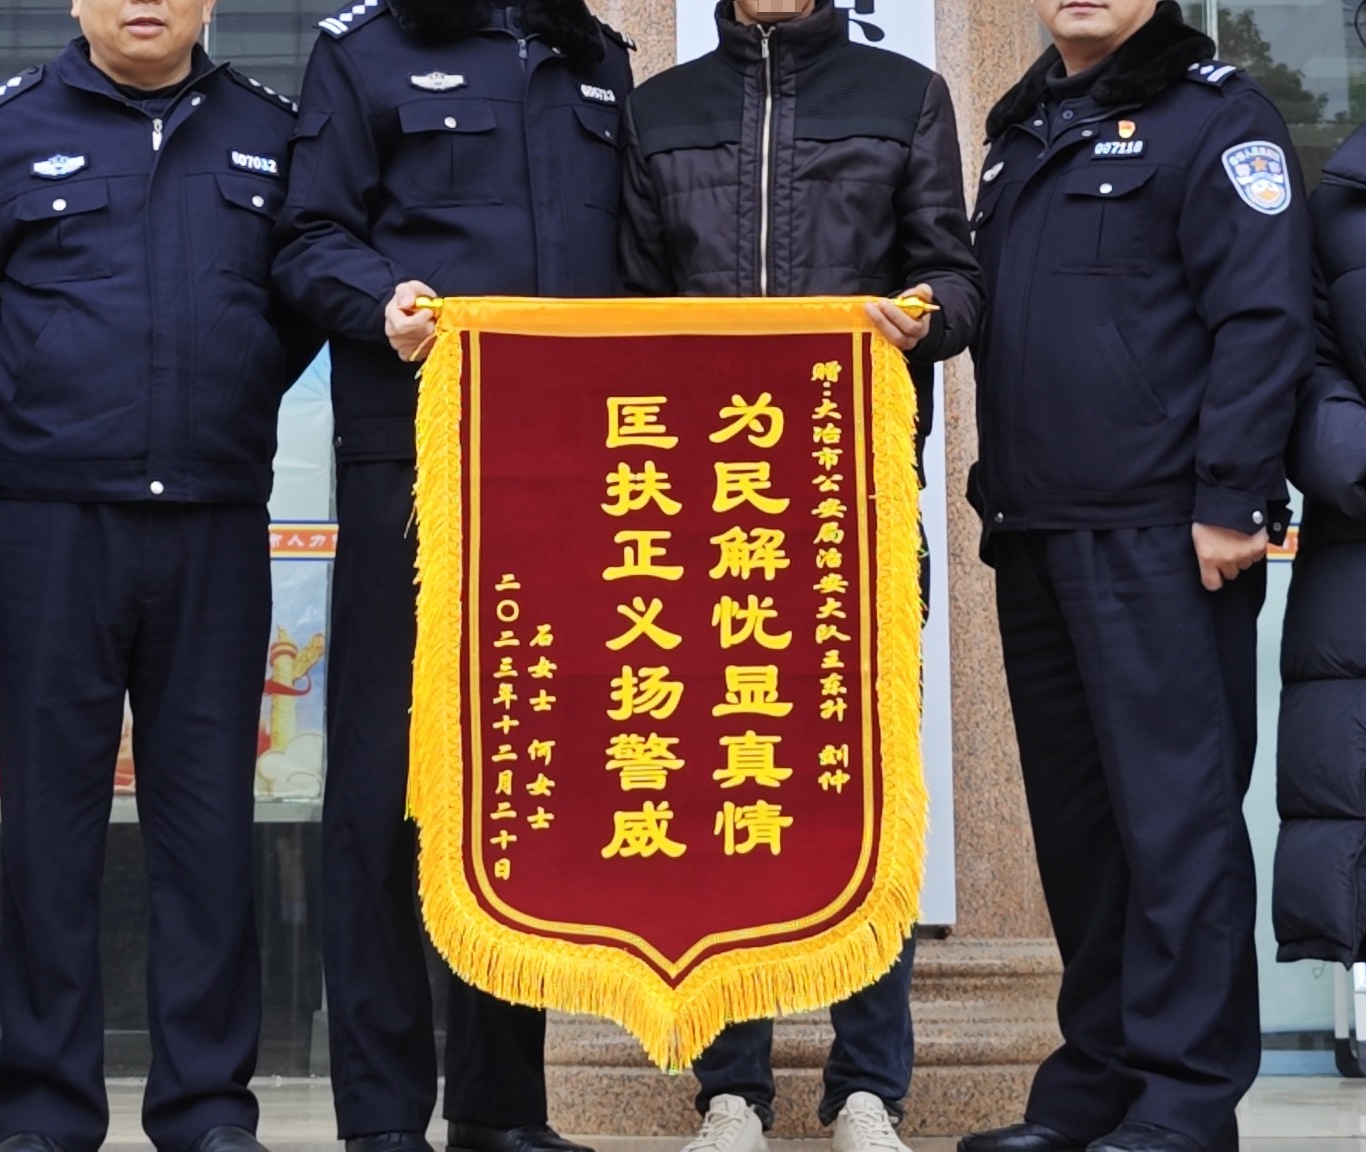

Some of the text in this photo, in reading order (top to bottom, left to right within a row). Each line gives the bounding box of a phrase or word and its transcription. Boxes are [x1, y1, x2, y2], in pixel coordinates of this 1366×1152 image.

[525, 623, 558, 831] 石女士 何女士
[600, 395, 688, 860] 匡扶正义扬警威
[708, 391, 794, 856] 为民解忧显真情
